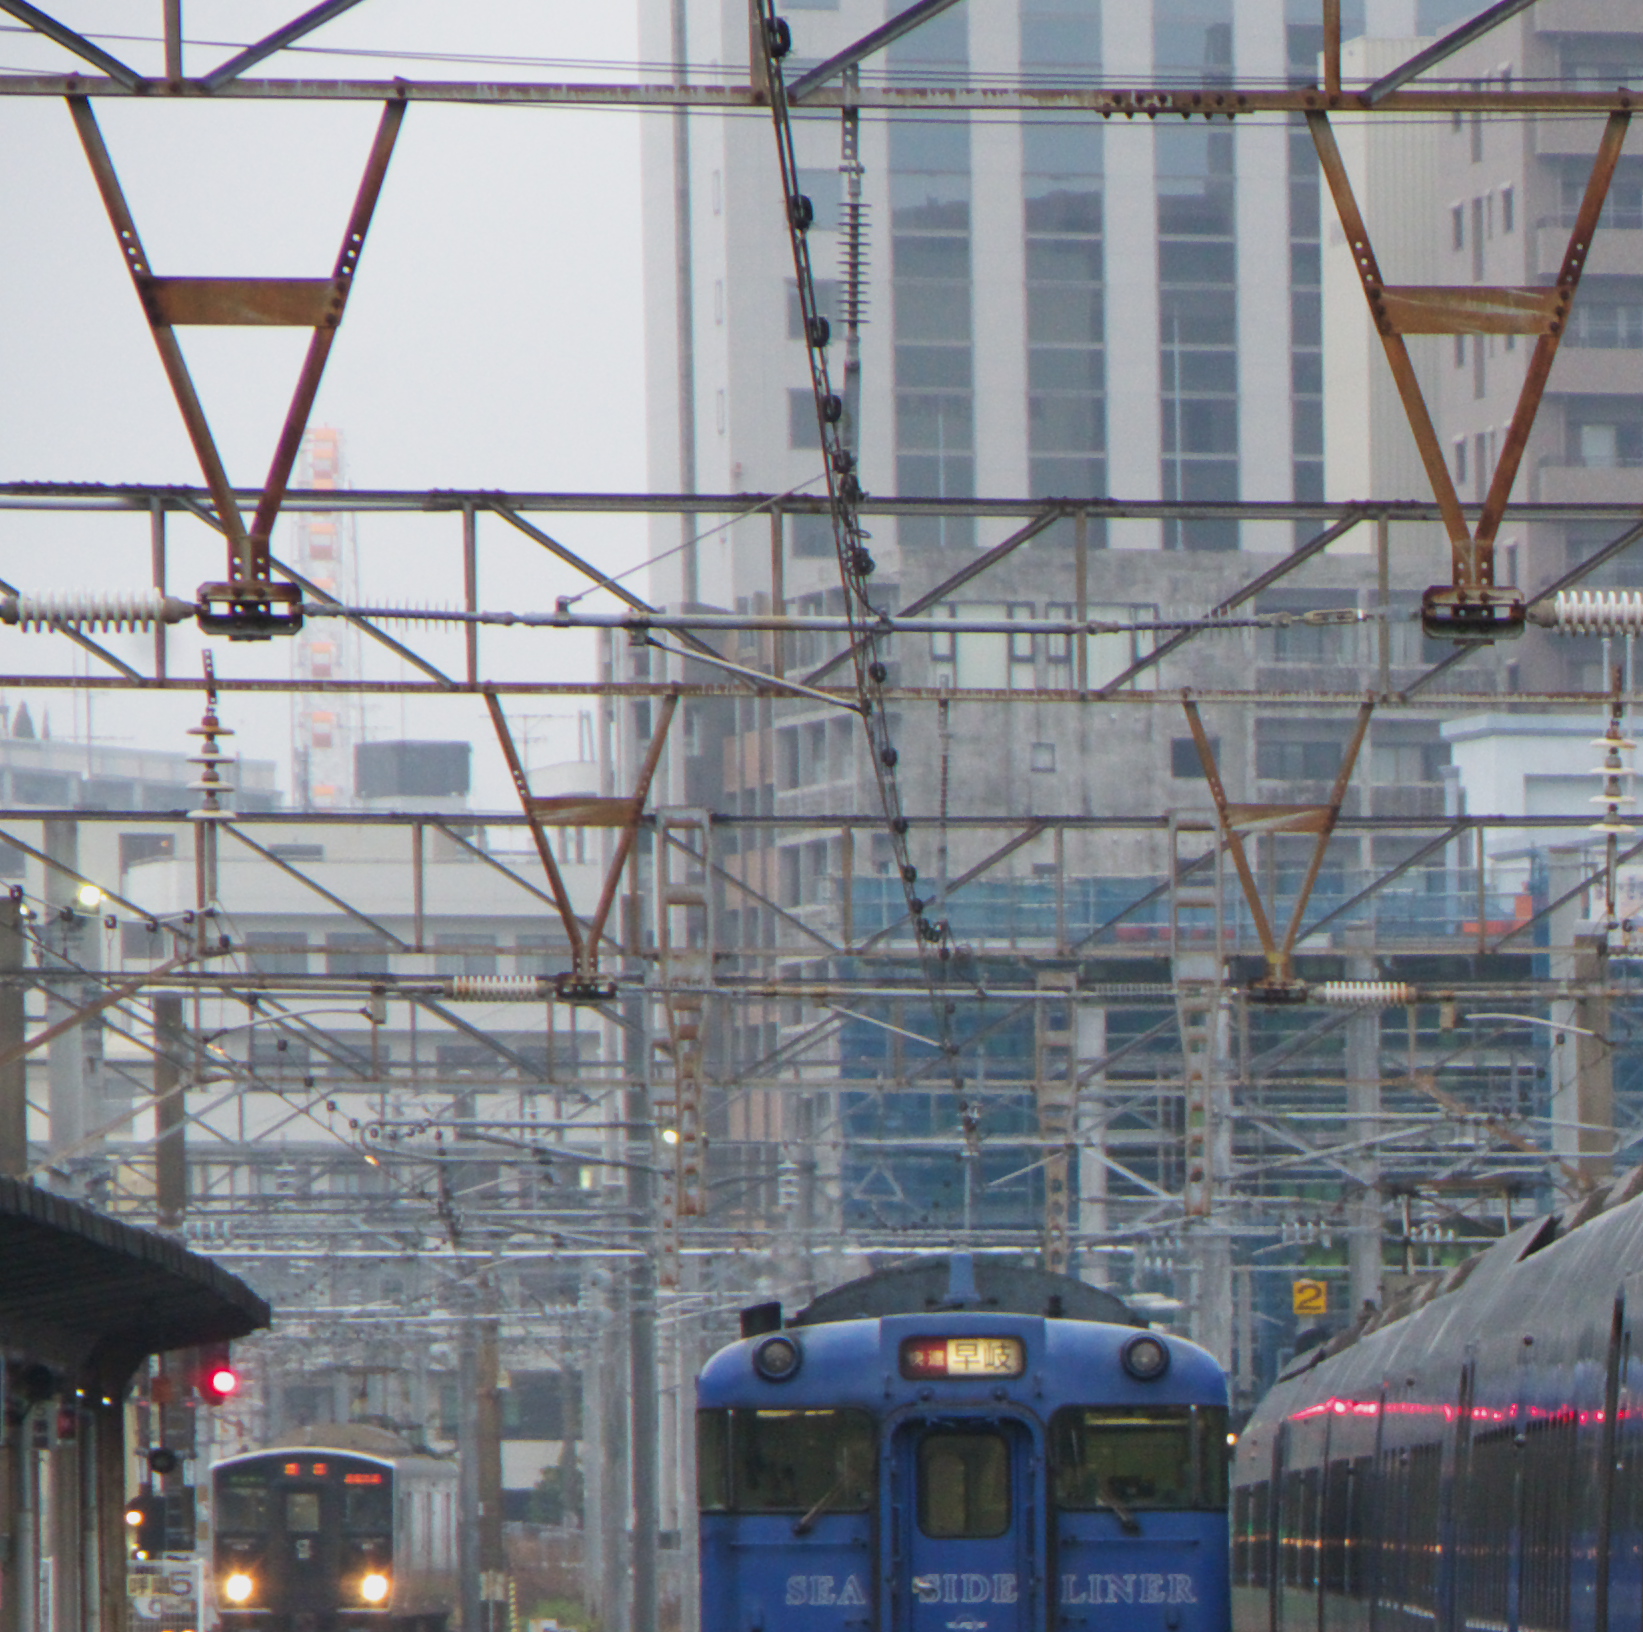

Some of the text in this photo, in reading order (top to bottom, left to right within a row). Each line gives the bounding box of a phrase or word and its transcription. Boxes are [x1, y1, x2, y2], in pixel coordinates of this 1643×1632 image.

[1297, 1284, 1323, 1311] 2
[785, 1574, 866, 1606] SEA
[1061, 1573, 1198, 1604] LINER
